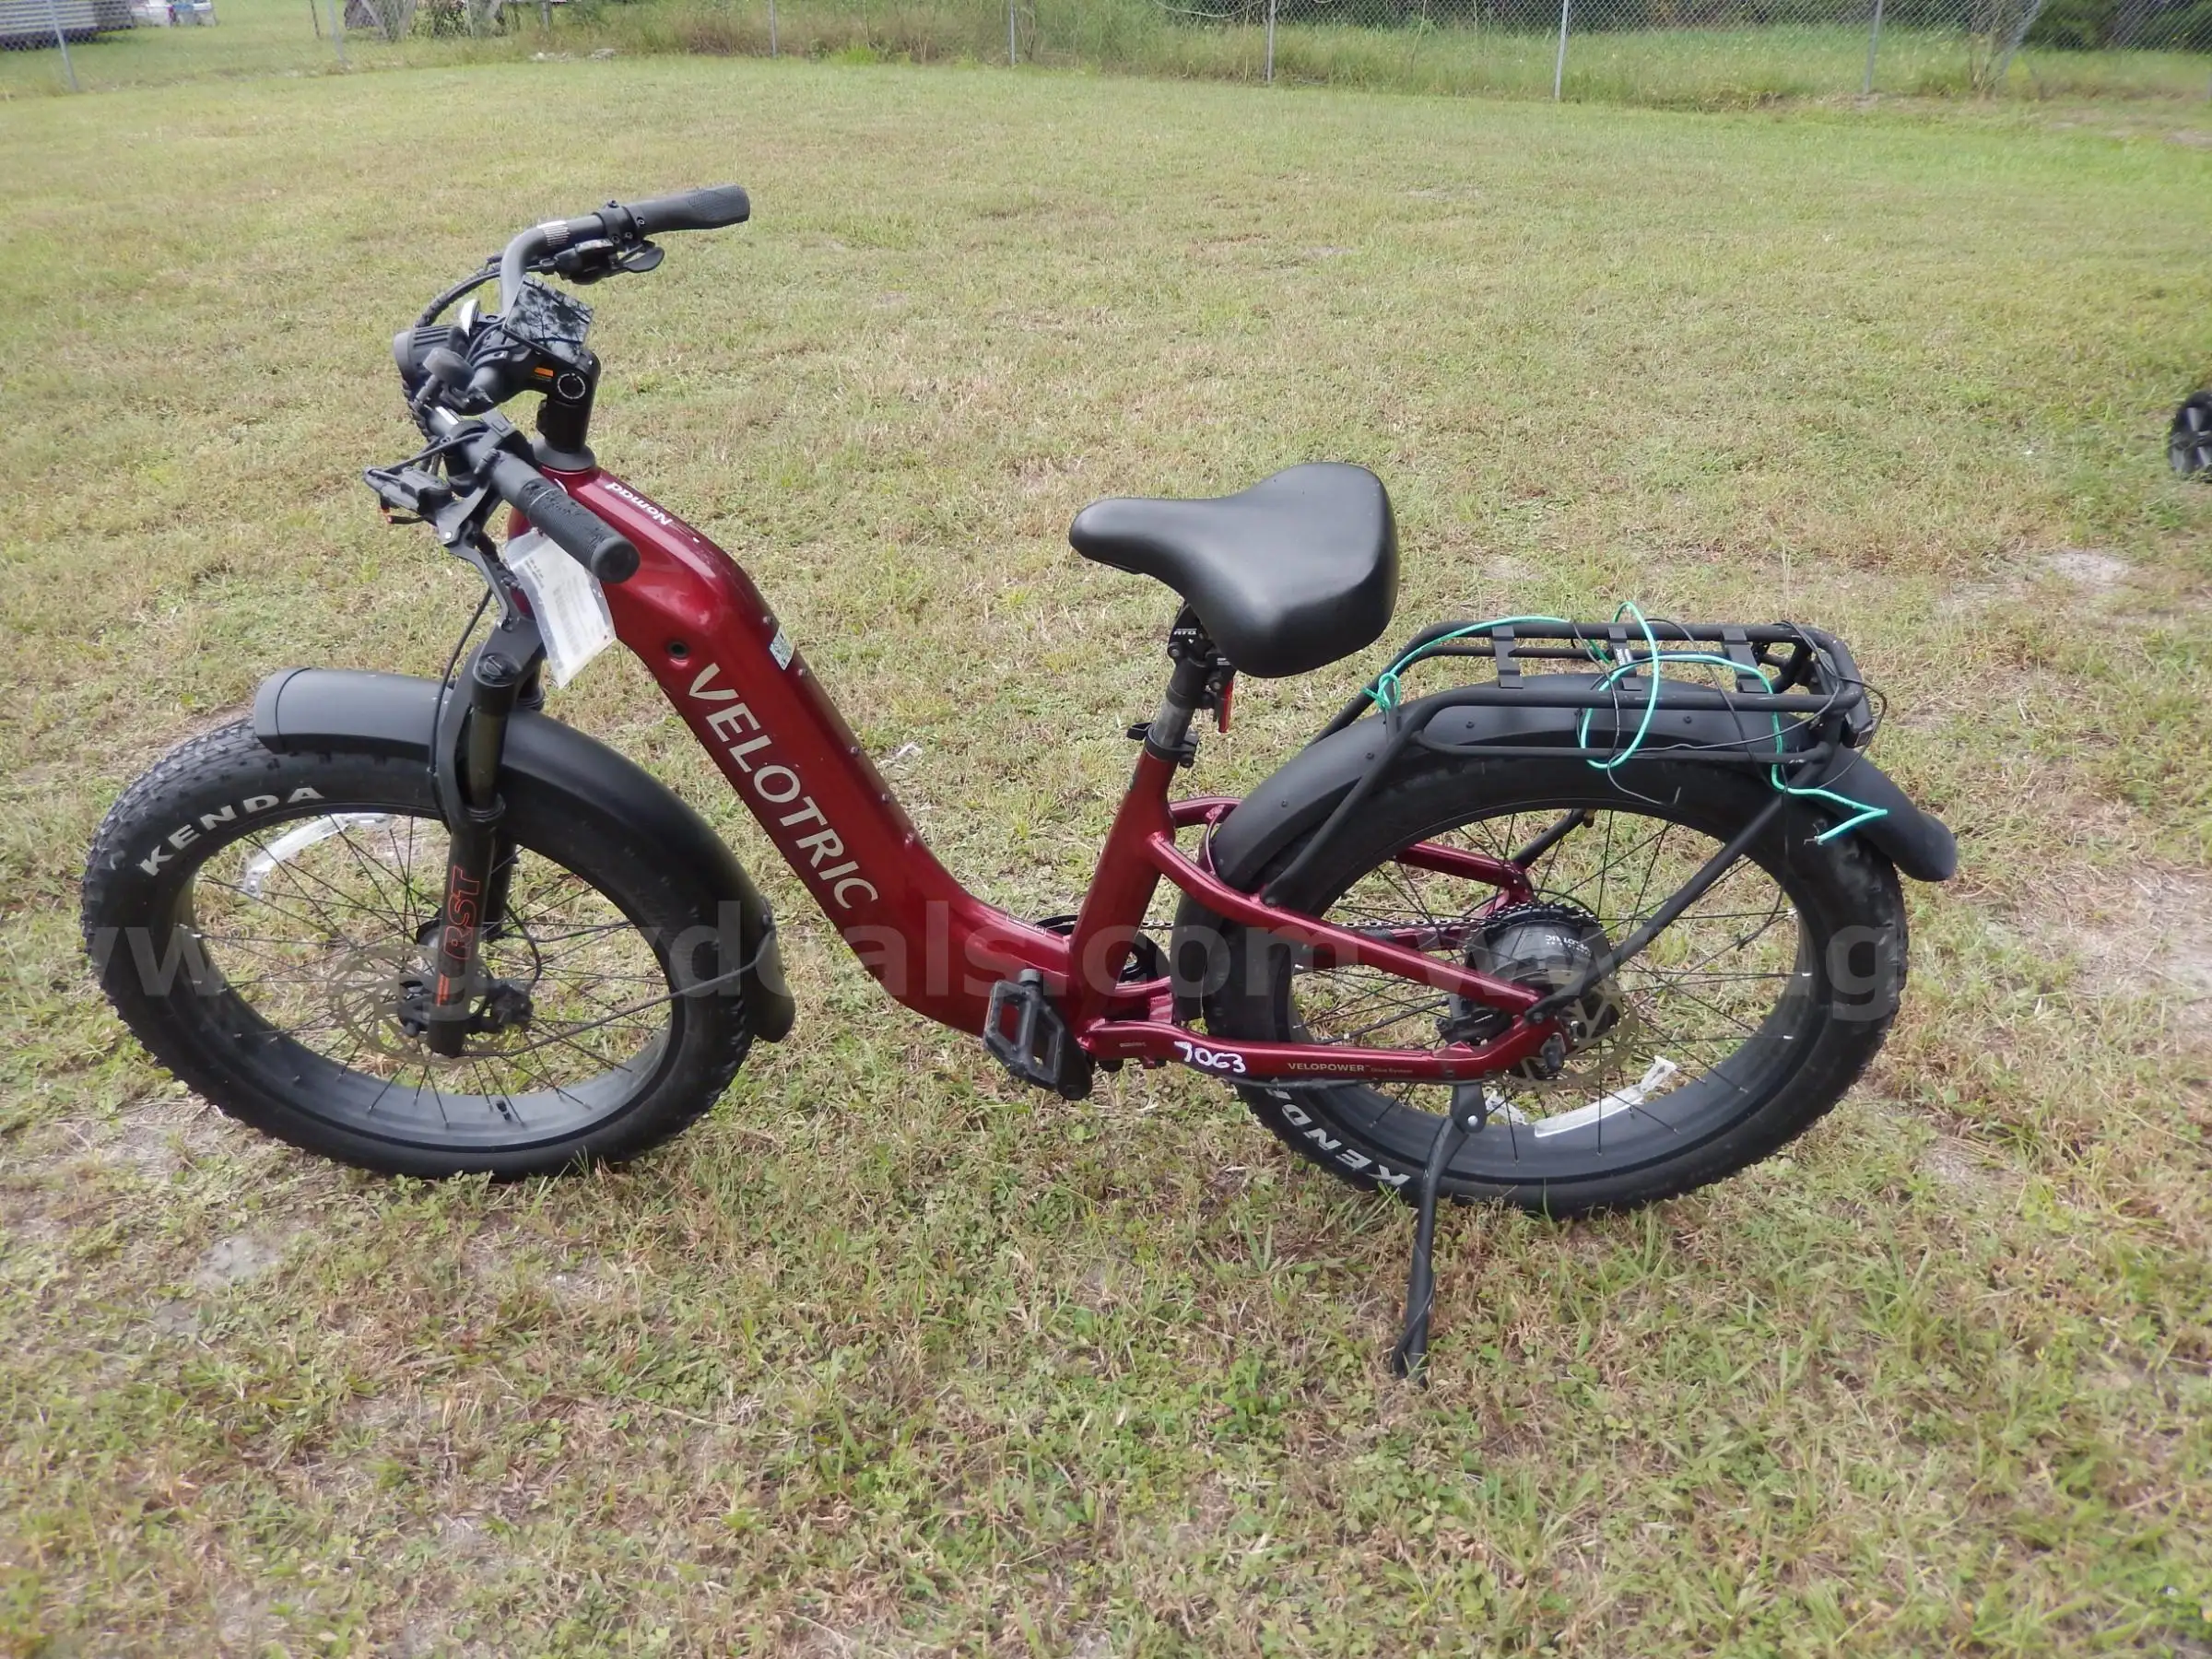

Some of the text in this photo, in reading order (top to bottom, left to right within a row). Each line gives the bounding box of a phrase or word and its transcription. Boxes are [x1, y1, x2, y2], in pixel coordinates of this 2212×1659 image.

[605, 482, 673, 525] Nomad
[689, 663, 878, 909] VELOTRIC
[139, 787, 325, 877] KENDA
[443, 865, 480, 960] RST
[1288, 1062, 1365, 1073] VELOPOWER
